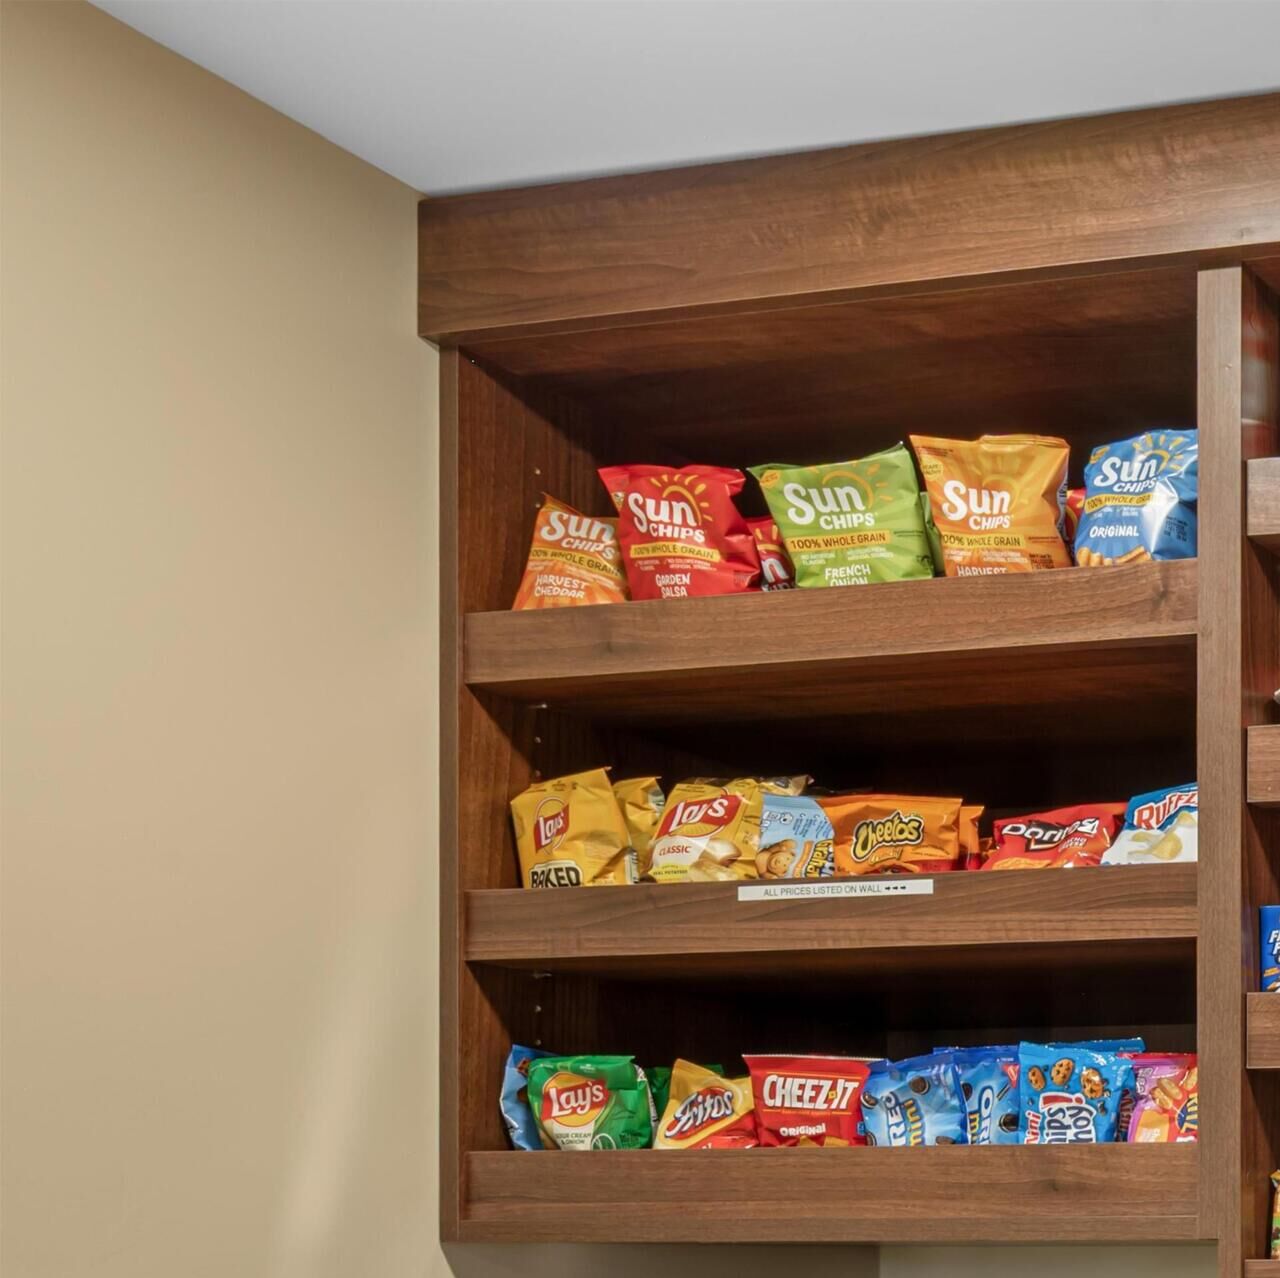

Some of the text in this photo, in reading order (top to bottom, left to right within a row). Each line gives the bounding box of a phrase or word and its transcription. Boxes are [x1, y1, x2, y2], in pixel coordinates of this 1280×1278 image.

[1094, 456, 1158, 486] Sun
[1113, 480, 1155, 493] CHIPS
[783, 483, 866, 526] Sun
[942, 481, 1010, 521] Sun
[628, 493, 698, 533] Sun
[820, 512, 875, 530] CHIPS
[969, 512, 1010, 531] CHIPS
[541, 511, 615, 542] Sun
[649, 523, 706, 543] CHIPS
[561, 537, 615, 560] CHIPS
[790, 532, 886, 550] 100% WHOLE GRAIN
[536, 574, 589, 589] HARVEST
[655, 572, 691, 585] GARDEN
[825, 563, 871, 580] FRENCH
[535, 585, 586, 599] CHEDDAR
[661, 586, 688, 599] SALSA
[852, 808, 925, 863] Cheetos
[659, 845, 693, 857] CLASSIC
[529, 865, 582, 888] BAKED
[764, 884, 881, 896] ALL PRICES LISTED ON WALL
[549, 1081, 604, 1117] Lay's
[762, 1074, 860, 1110] CHEEZ-IT
[665, 1090, 735, 1138] Fritos
